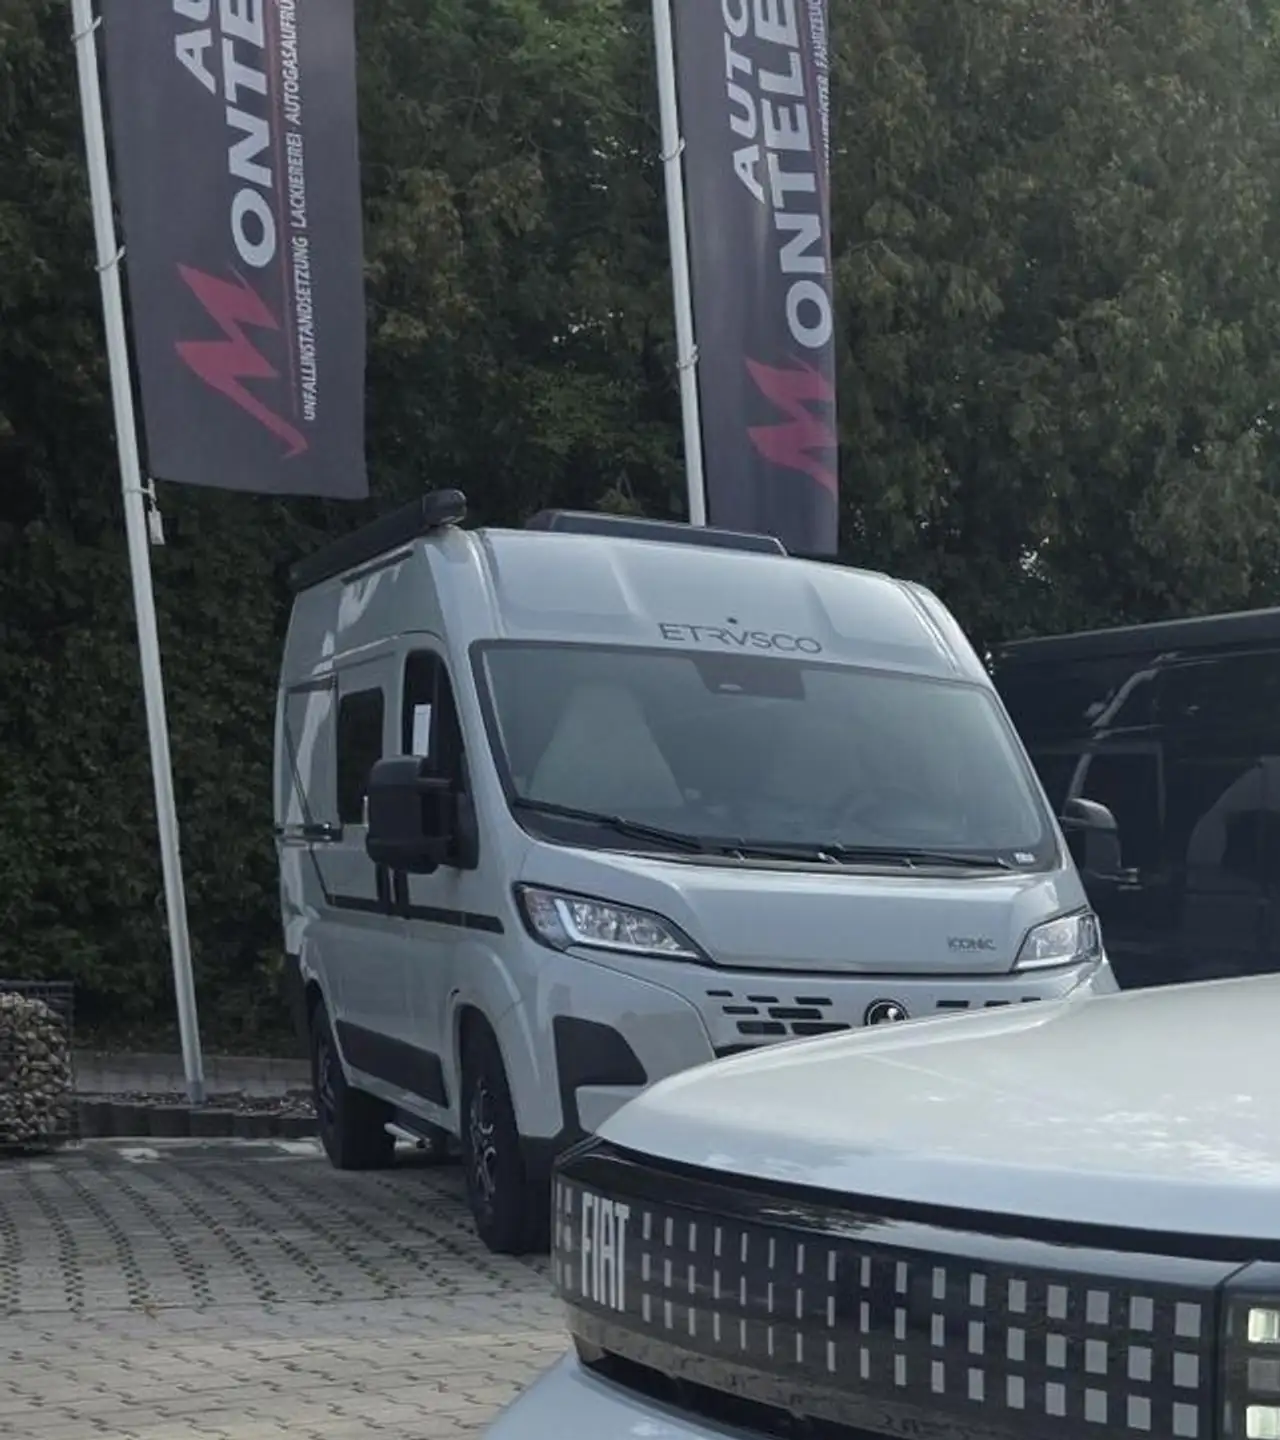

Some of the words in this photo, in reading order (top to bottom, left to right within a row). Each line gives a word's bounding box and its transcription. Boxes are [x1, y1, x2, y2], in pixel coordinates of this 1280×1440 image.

[284, 131, 308, 228] LACKIEREREI
[291, 236, 317, 421] UNFALLINSTANDSETZUNG
[581, 1192, 630, 1312] FIAT
